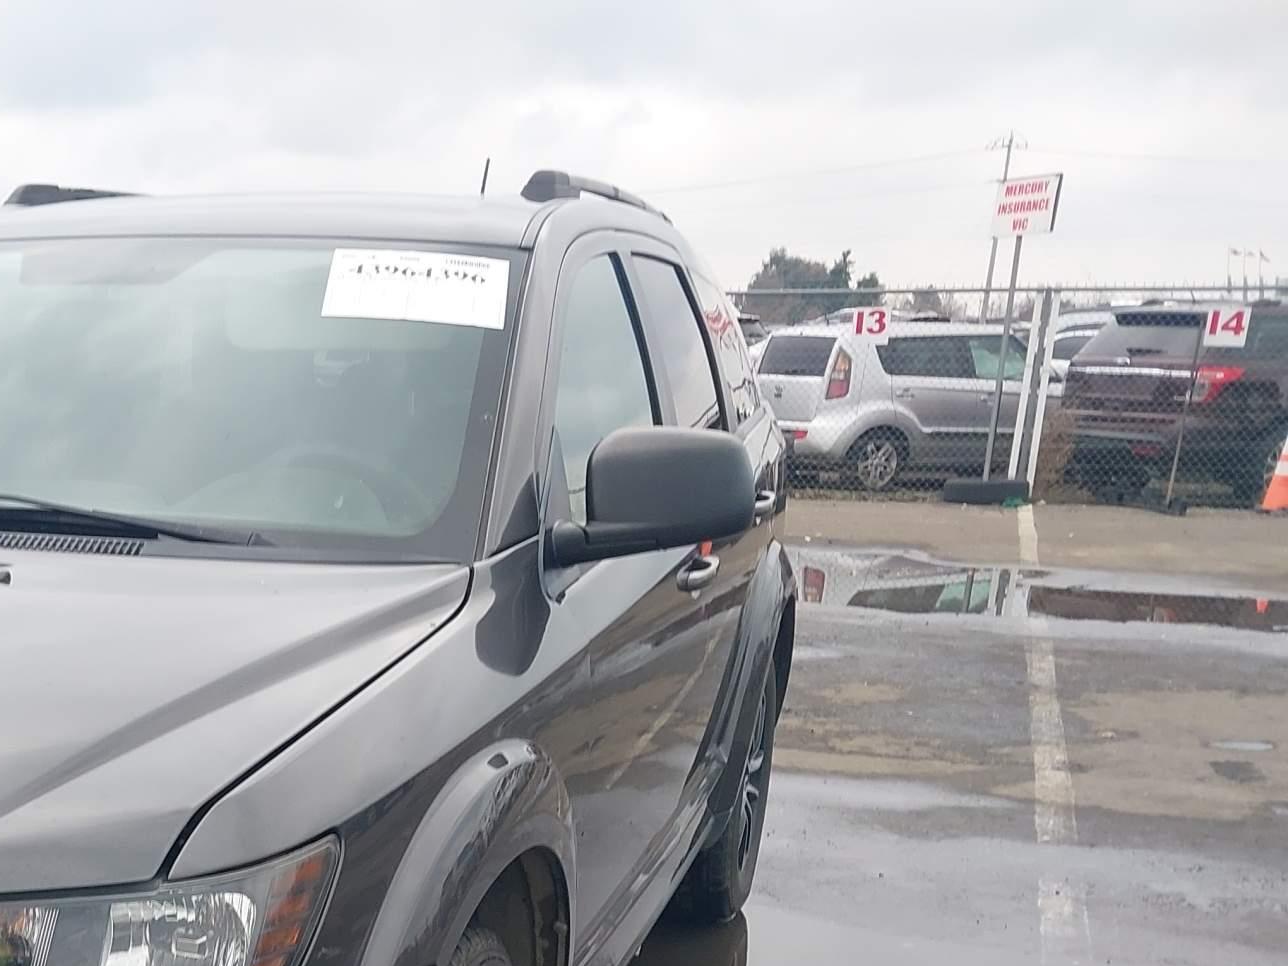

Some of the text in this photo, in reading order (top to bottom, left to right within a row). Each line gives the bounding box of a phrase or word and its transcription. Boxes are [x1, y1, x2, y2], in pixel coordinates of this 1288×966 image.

[1005, 181, 1050, 198] MERCURY
[998, 198, 1050, 216] INSURANCE
[855, 310, 886, 334] 13
[1208, 310, 1245, 336] 14
